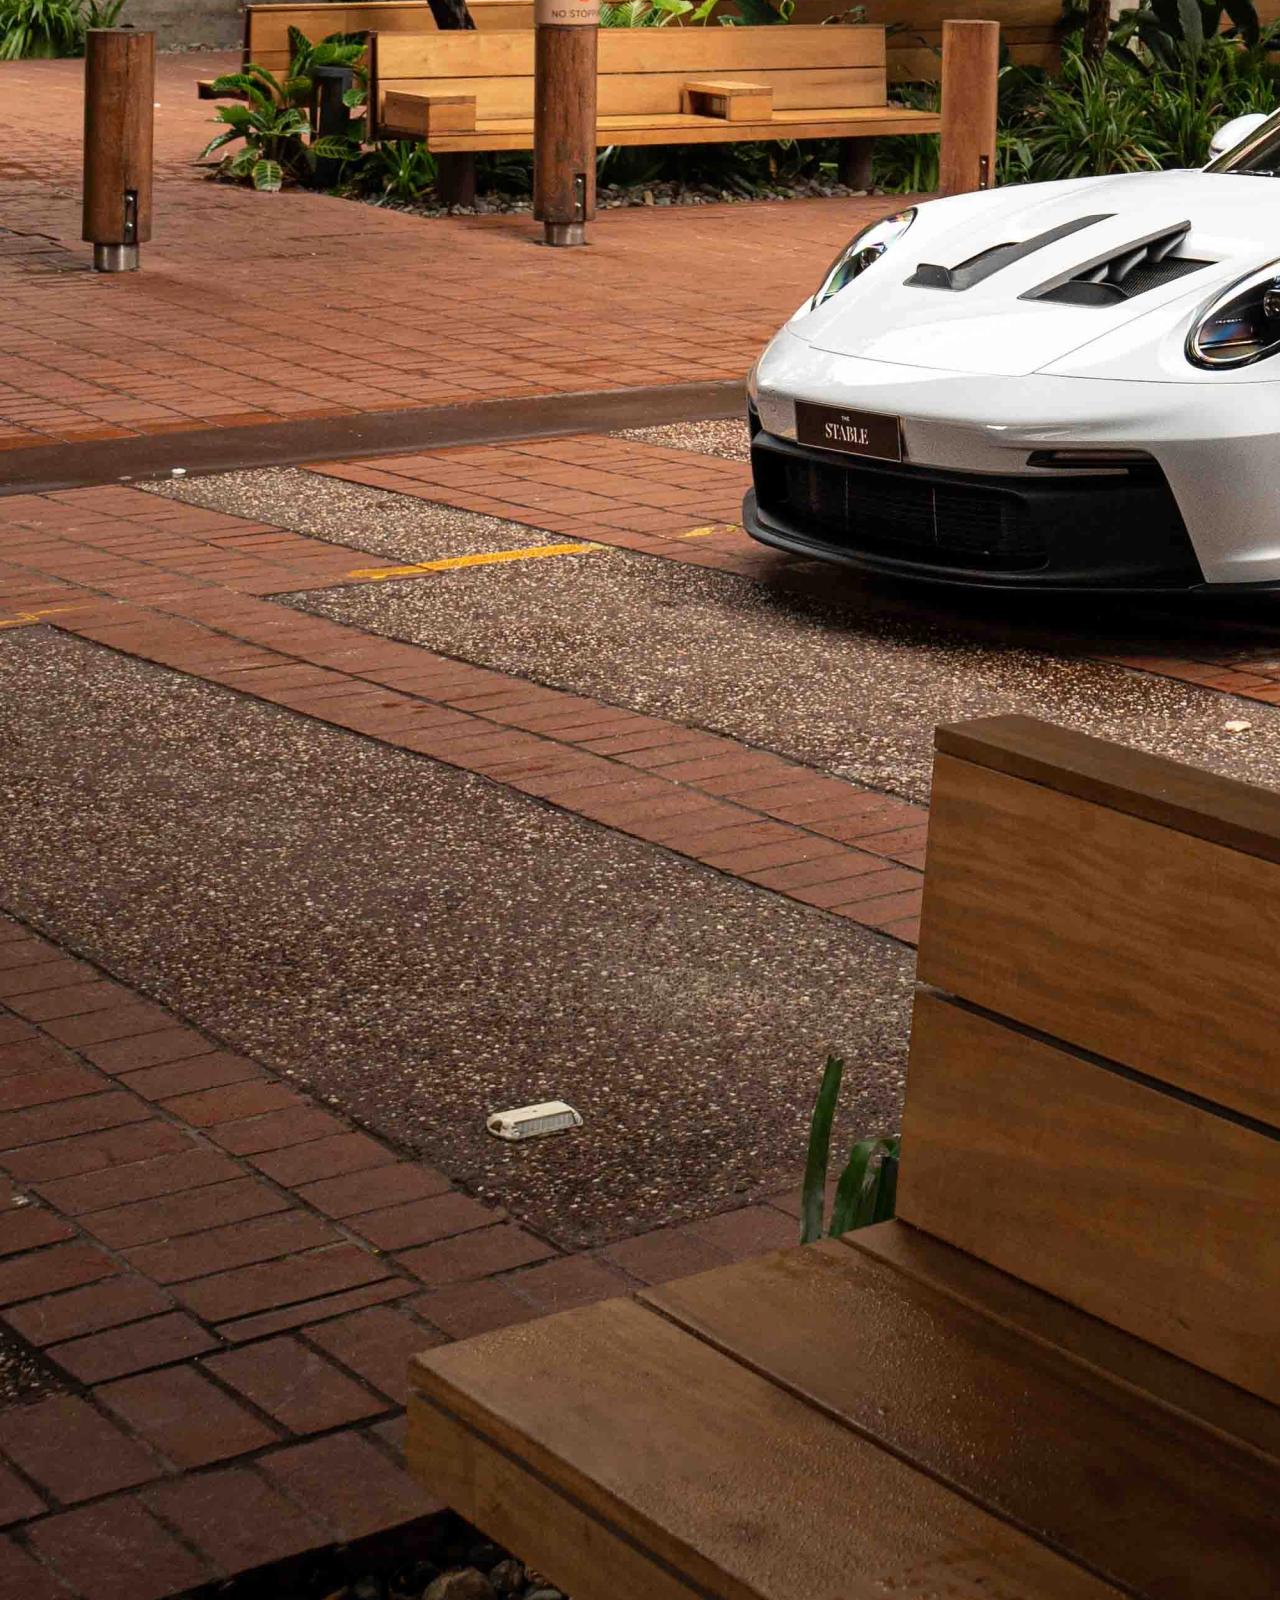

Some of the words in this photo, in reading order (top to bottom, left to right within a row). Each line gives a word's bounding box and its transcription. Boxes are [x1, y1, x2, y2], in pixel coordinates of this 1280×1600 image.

[551, 9, 567, 18] NO
[569, 9, 598, 18] STOPP
[825, 423, 869, 445] STABLE
